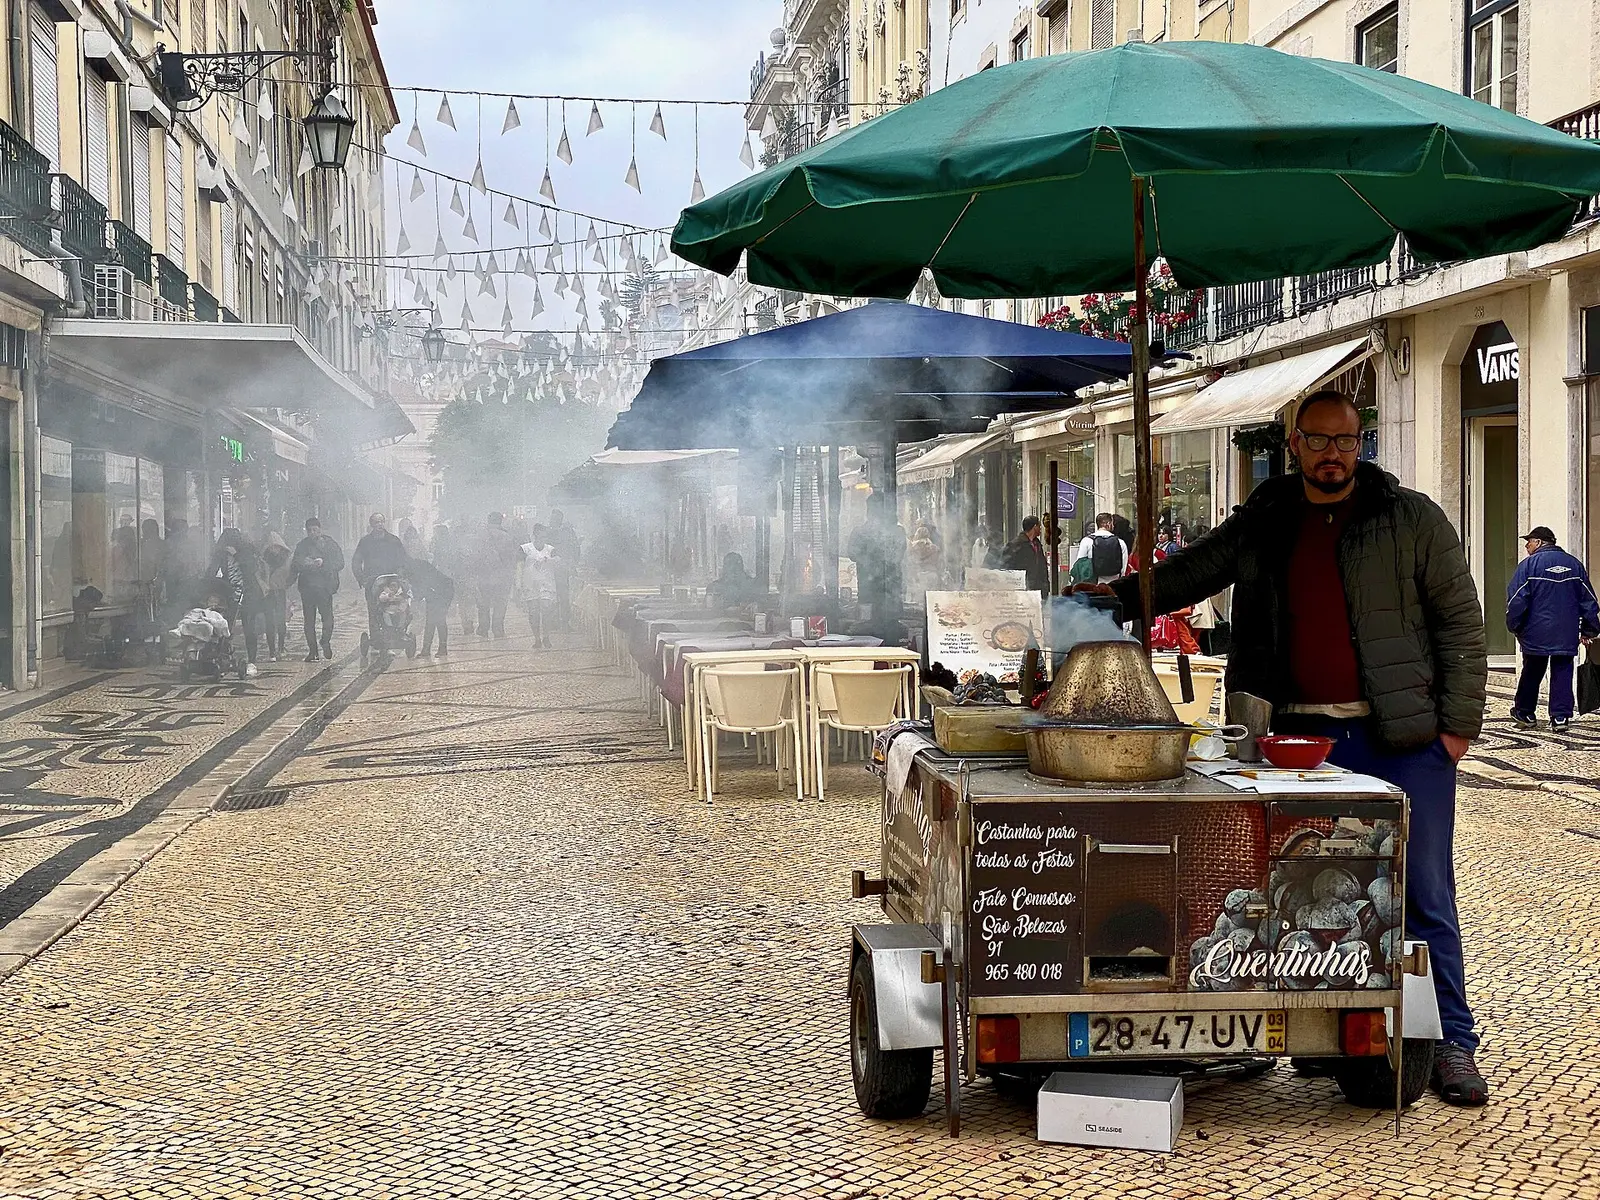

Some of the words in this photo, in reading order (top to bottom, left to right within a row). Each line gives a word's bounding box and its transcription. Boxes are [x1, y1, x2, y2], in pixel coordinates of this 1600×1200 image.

[1476, 341, 1520, 385] VANS
[976, 820, 1045, 845] Castanhas
[1045, 826, 1078, 848] para
[974, 851, 1012, 869] todas
[1013, 853, 1030, 868] as
[1031, 847, 1076, 875] Festas
[972, 886, 1008, 914] Fale
[1011, 886, 1077, 911] Connosco:
[981, 914, 1012, 941] São
[1012, 914, 1068, 939] Belezas
[985, 963, 1010, 981] 965
[1012, 963, 1037, 981] 480
[1040, 962, 1063, 981] 018
[1188, 938, 1374, 988] Quentinhas
[1267, 1013, 1284, 1026] 03
[1074, 1039, 1083, 1050] P
[1267, 1036, 1284, 1049] 04
